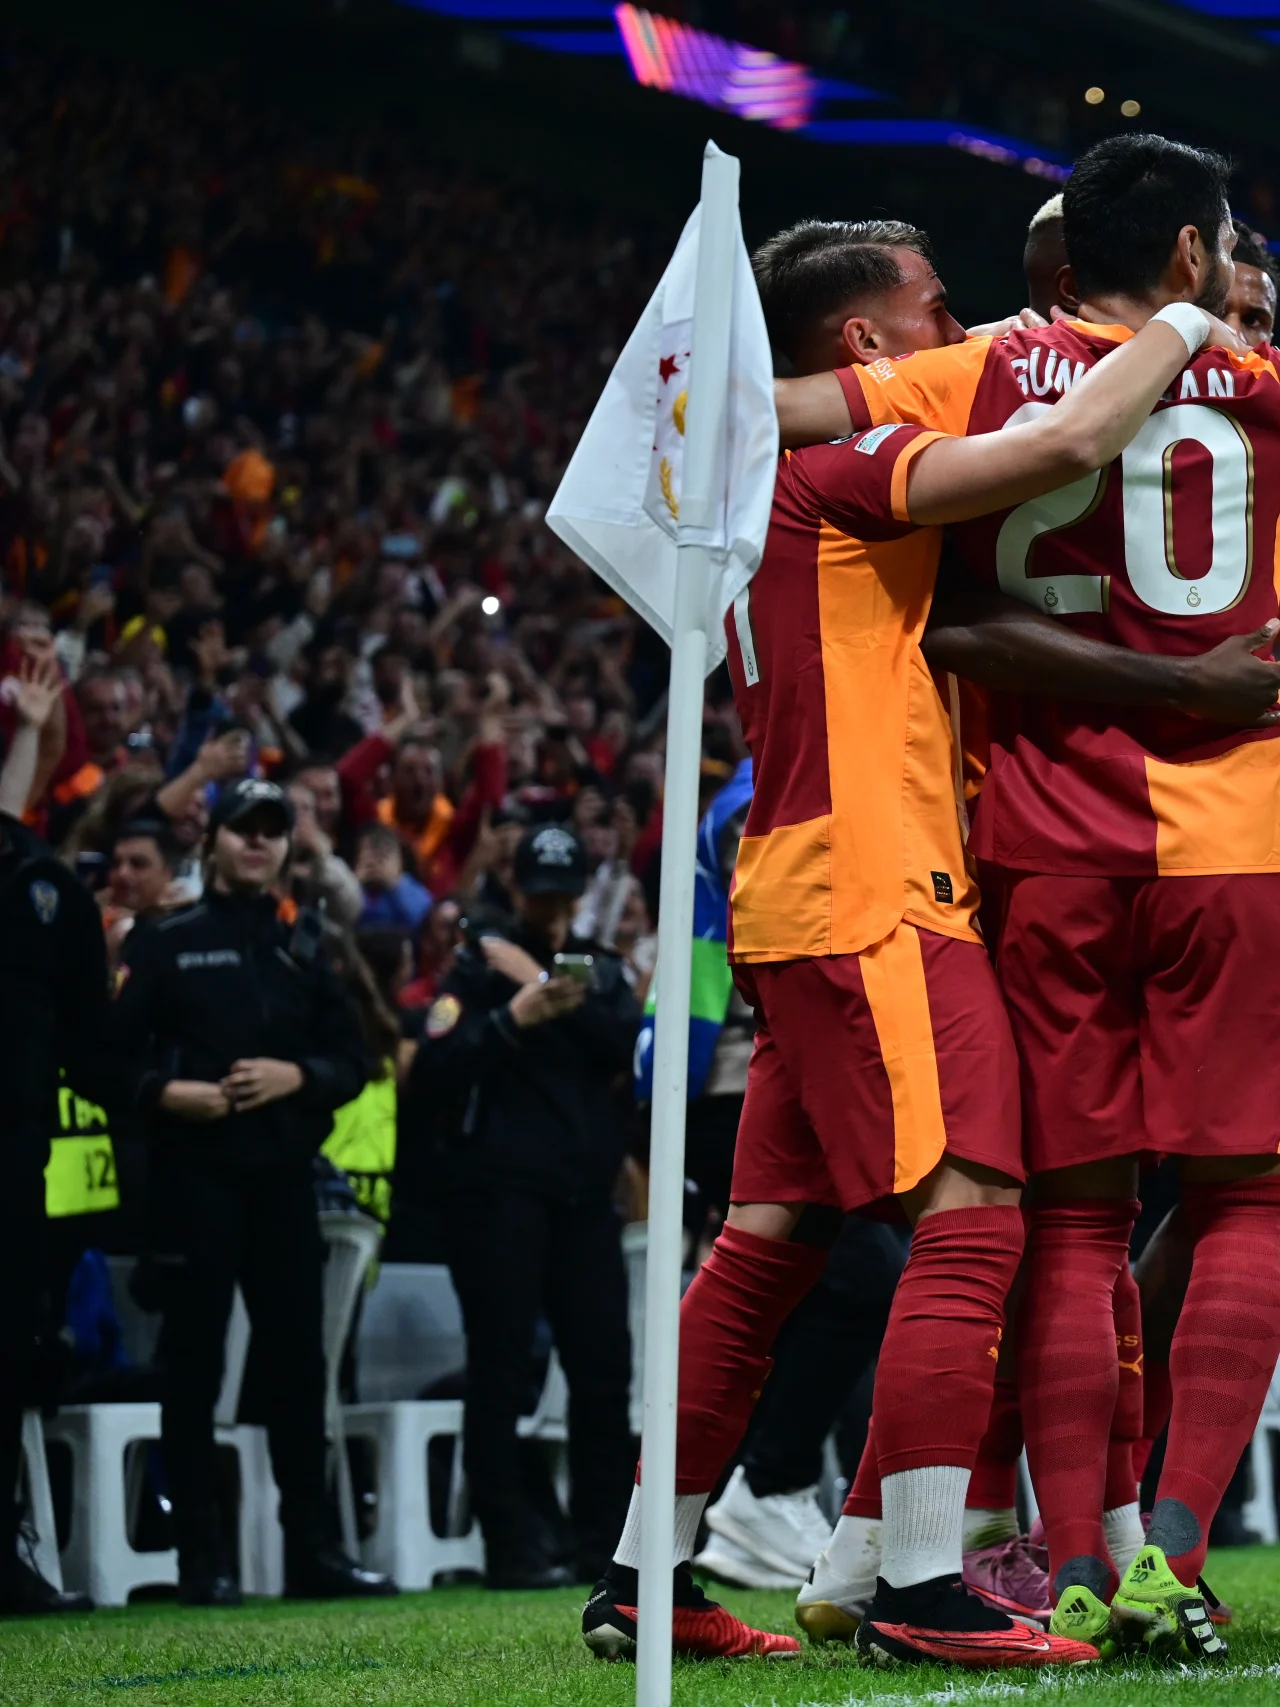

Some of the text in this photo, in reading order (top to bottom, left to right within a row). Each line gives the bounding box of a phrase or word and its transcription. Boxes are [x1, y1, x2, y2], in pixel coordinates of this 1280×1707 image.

[1010, 346, 1235, 398] GÜNAN
[995, 402, 1255, 615] 20
[1129, 1569, 1149, 1584] 20
[1063, 1614, 1088, 1628] 20
